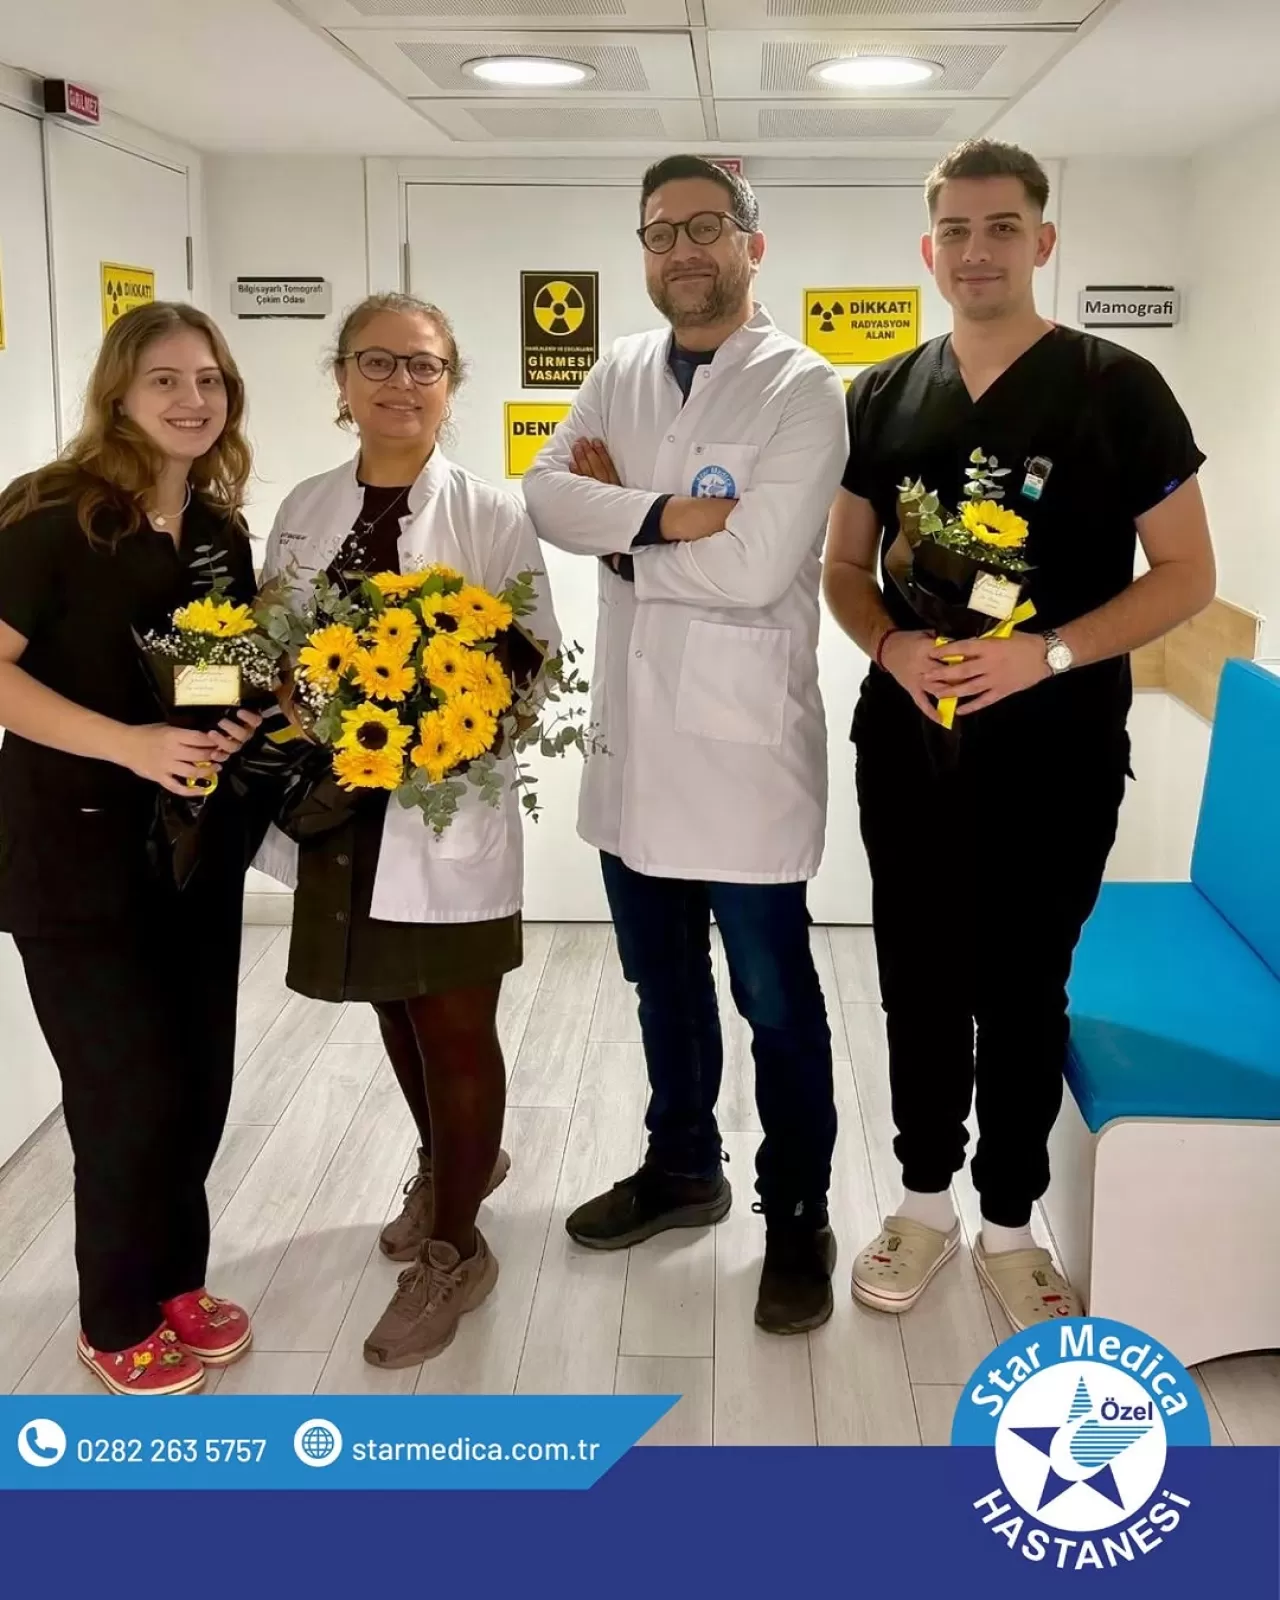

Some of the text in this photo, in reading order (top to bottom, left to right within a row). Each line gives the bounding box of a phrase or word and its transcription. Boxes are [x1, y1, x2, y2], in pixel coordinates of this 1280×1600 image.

[238, 284, 282, 294] Bilgisayarlı
[256, 295, 306, 305] Çekim Odası
[849, 300, 912, 314] DİKKAT!
[1085, 300, 1173, 318] Mamografi
[850, 319, 911, 329] RADYASYON
[865, 330, 896, 340] ALANI
[528, 353, 591, 366] GİRMESİ
